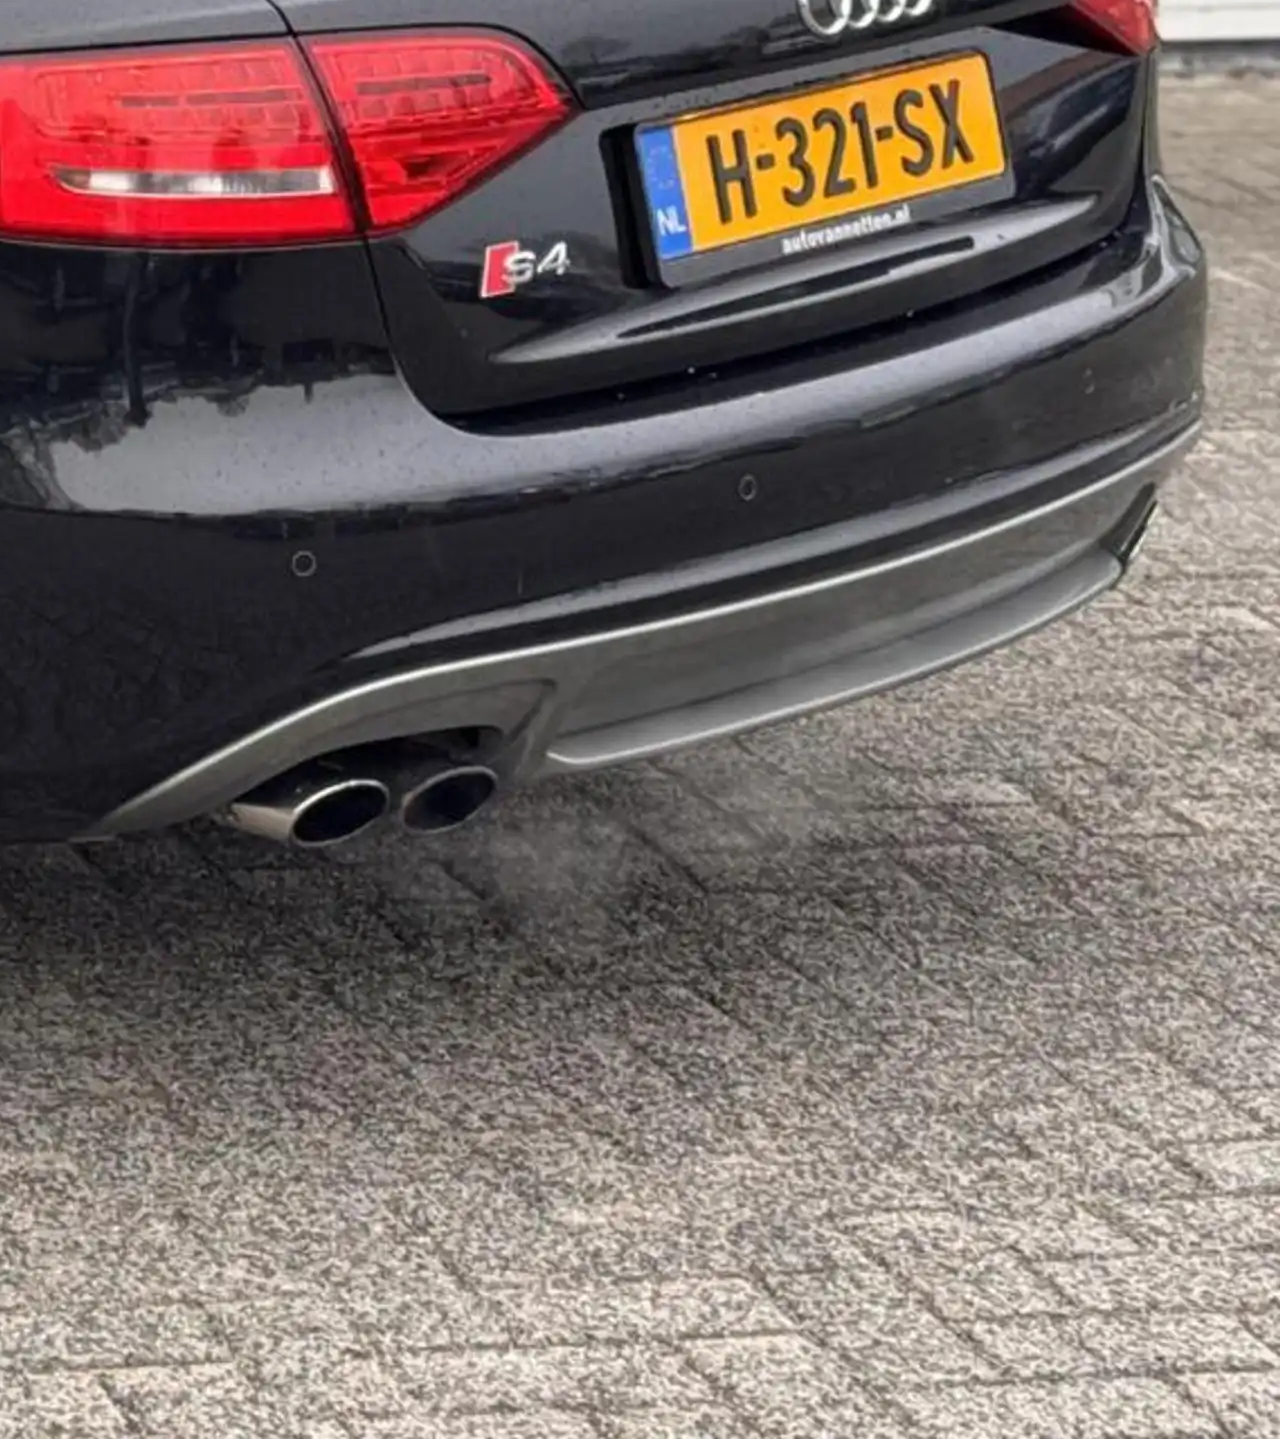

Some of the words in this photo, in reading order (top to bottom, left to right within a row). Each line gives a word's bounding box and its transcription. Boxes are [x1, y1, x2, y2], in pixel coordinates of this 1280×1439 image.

[705, 78, 974, 225] H-321-SX
[656, 205, 687, 237] NL
[781, 202, 911, 255] autovannetten.nl
[502, 241, 571, 284] S4
